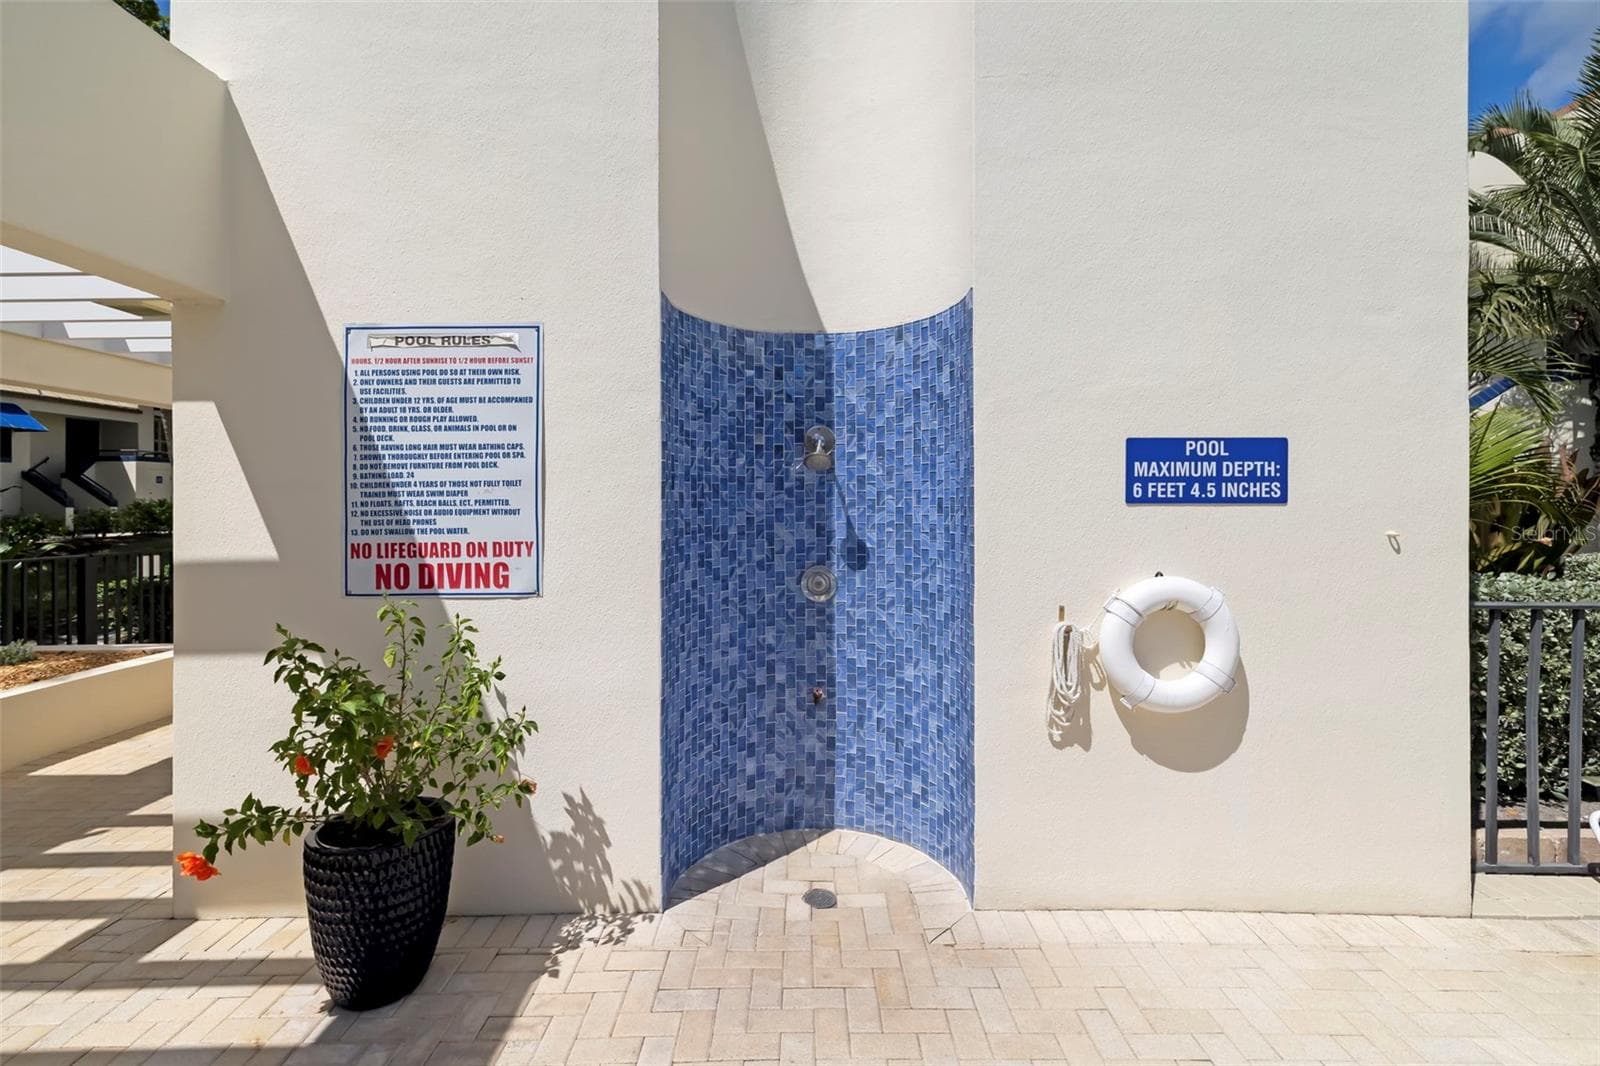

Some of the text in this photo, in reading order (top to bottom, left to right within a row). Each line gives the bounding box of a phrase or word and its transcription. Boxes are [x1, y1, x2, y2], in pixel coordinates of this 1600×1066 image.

[395, 336, 491, 345] POOL RULES
[1186, 441, 1229, 456] POOL
[1134, 462, 1280, 477] MAXIMUM DEPTH:
[1133, 483, 1281, 498] 6 FEET 4.5 INCHES
[351, 541, 534, 559] NO LIFEGUARD ON DUTY
[376, 563, 509, 589] NO DIVING
